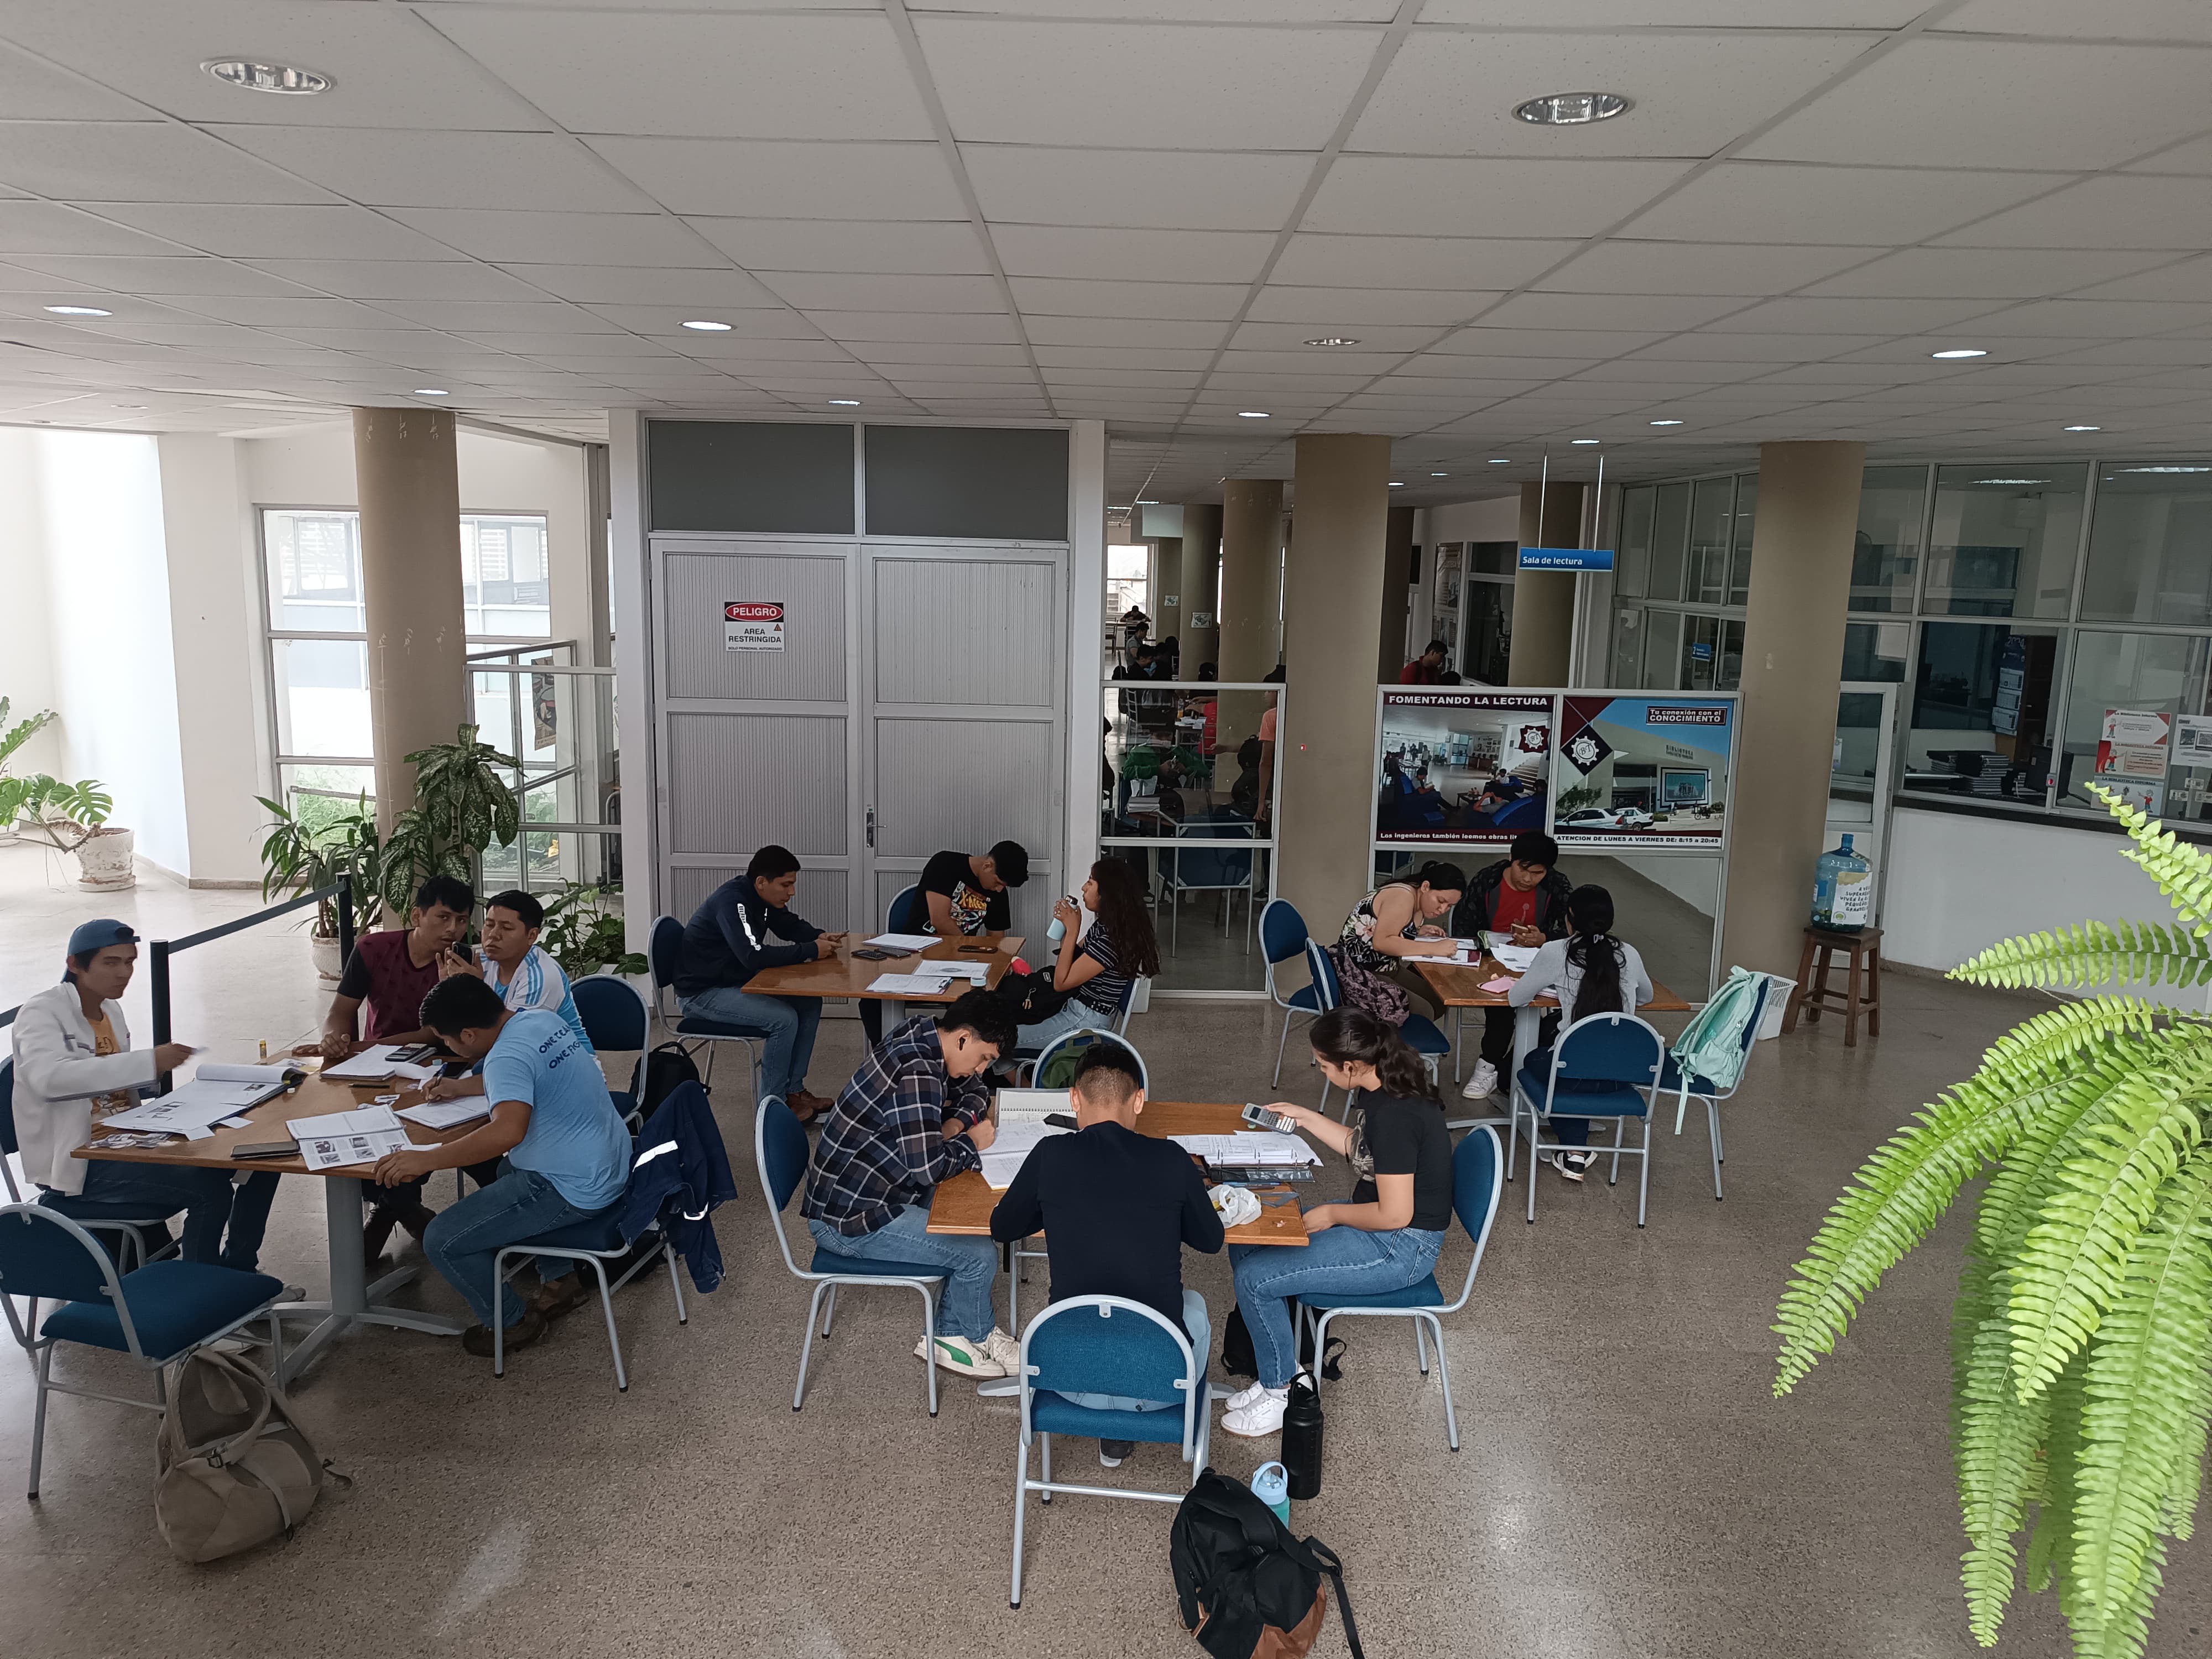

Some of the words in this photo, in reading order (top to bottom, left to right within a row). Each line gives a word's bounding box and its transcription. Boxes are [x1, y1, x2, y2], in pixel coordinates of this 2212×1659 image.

[1522, 556, 1540, 564] Sala
[1553, 557, 1583, 565] lectura
[733, 607, 777, 617] PELIGRO
[1389, 696, 1470, 705] FOMENTANDO
[1493, 697, 1547, 706] LECTURA
[539, 1036, 557, 1053] ONE
[549, 1049, 570, 1069] ONE
